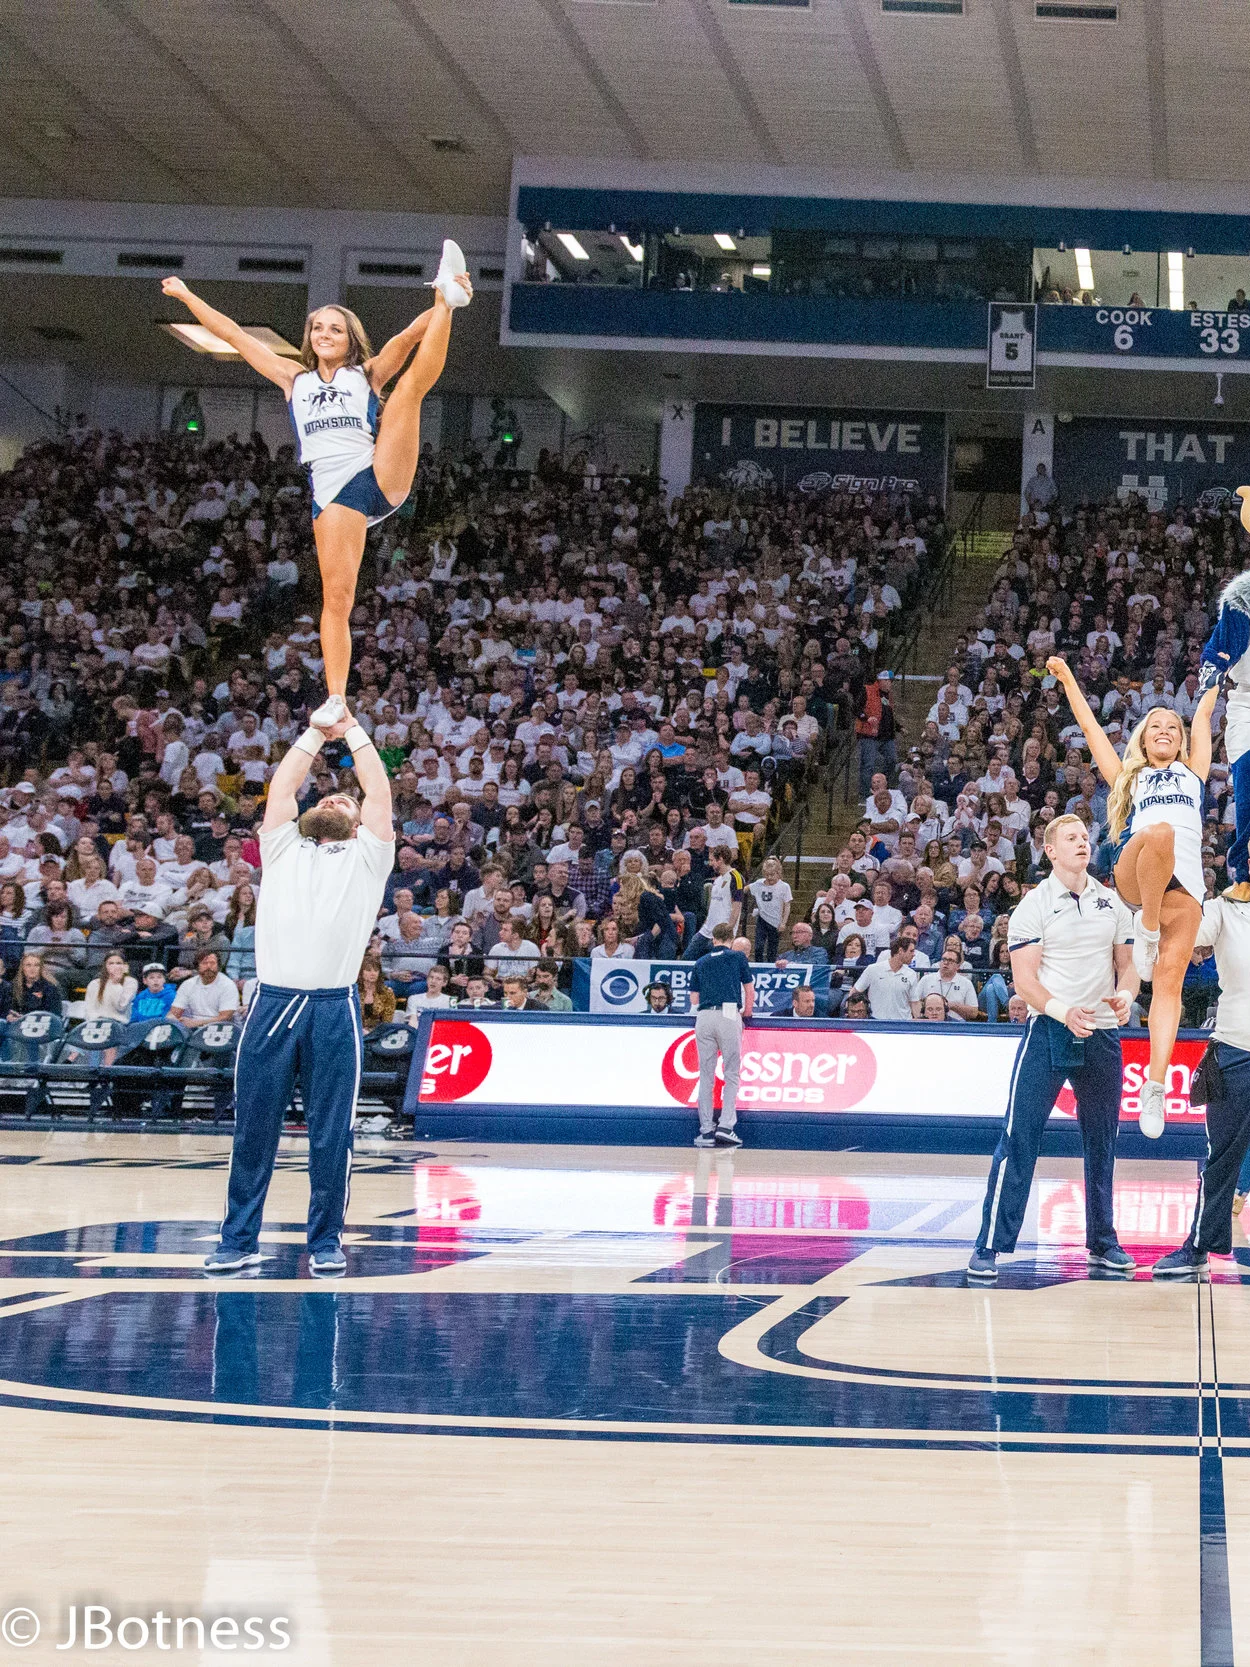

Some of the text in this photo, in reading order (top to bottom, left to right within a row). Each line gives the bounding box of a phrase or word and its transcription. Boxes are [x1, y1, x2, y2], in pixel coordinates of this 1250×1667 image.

[1096, 309, 1153, 326] COOK
[1190, 312, 1250, 329] ESTES
[1113, 325, 1135, 350] 6
[1199, 328, 1241, 354] 33
[1004, 342, 1018, 360] 5
[672, 405, 684, 421] X
[303, 416, 363, 436] UTAH STATE
[720, 417, 923, 453] I BELIEVE
[1031, 419, 1046, 435] A
[1118, 431, 1234, 465] THAT
[1140, 794, 1195, 811] UTAH STATE
